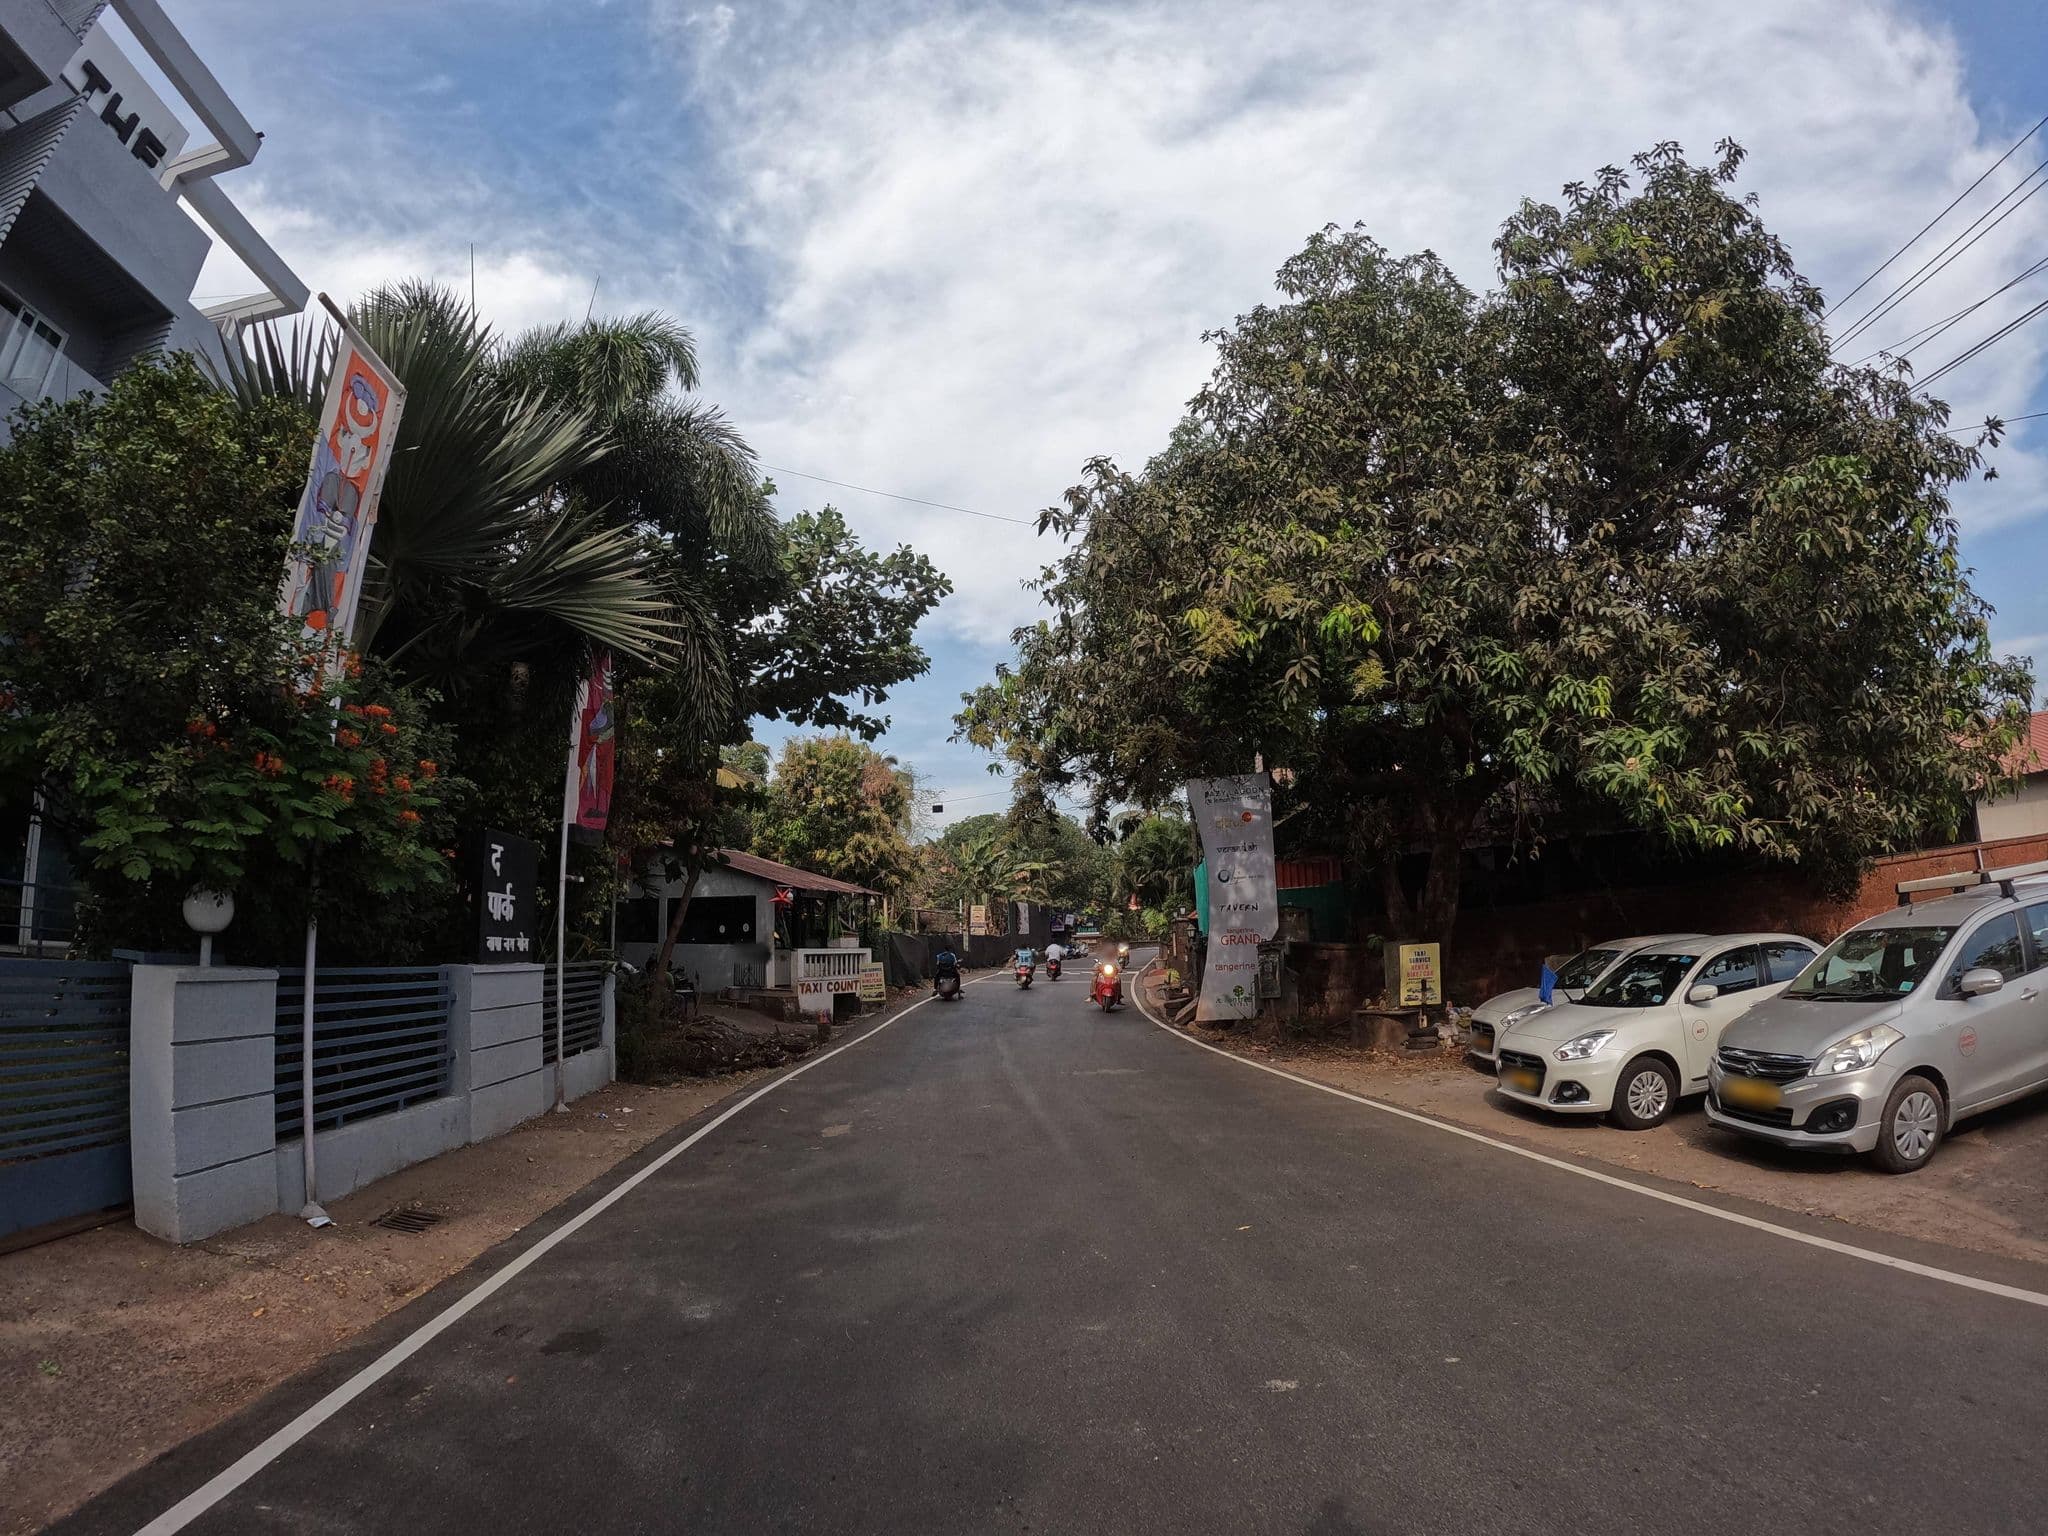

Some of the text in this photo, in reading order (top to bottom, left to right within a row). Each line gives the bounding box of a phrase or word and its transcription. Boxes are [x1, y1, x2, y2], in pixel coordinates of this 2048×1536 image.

[1219, 903, 1259, 912] TAVERN
[1220, 934, 1261, 946] GRAND
[1215, 962, 1256, 972] tangerine
[799, 979, 861, 994] TAXI COUNT
